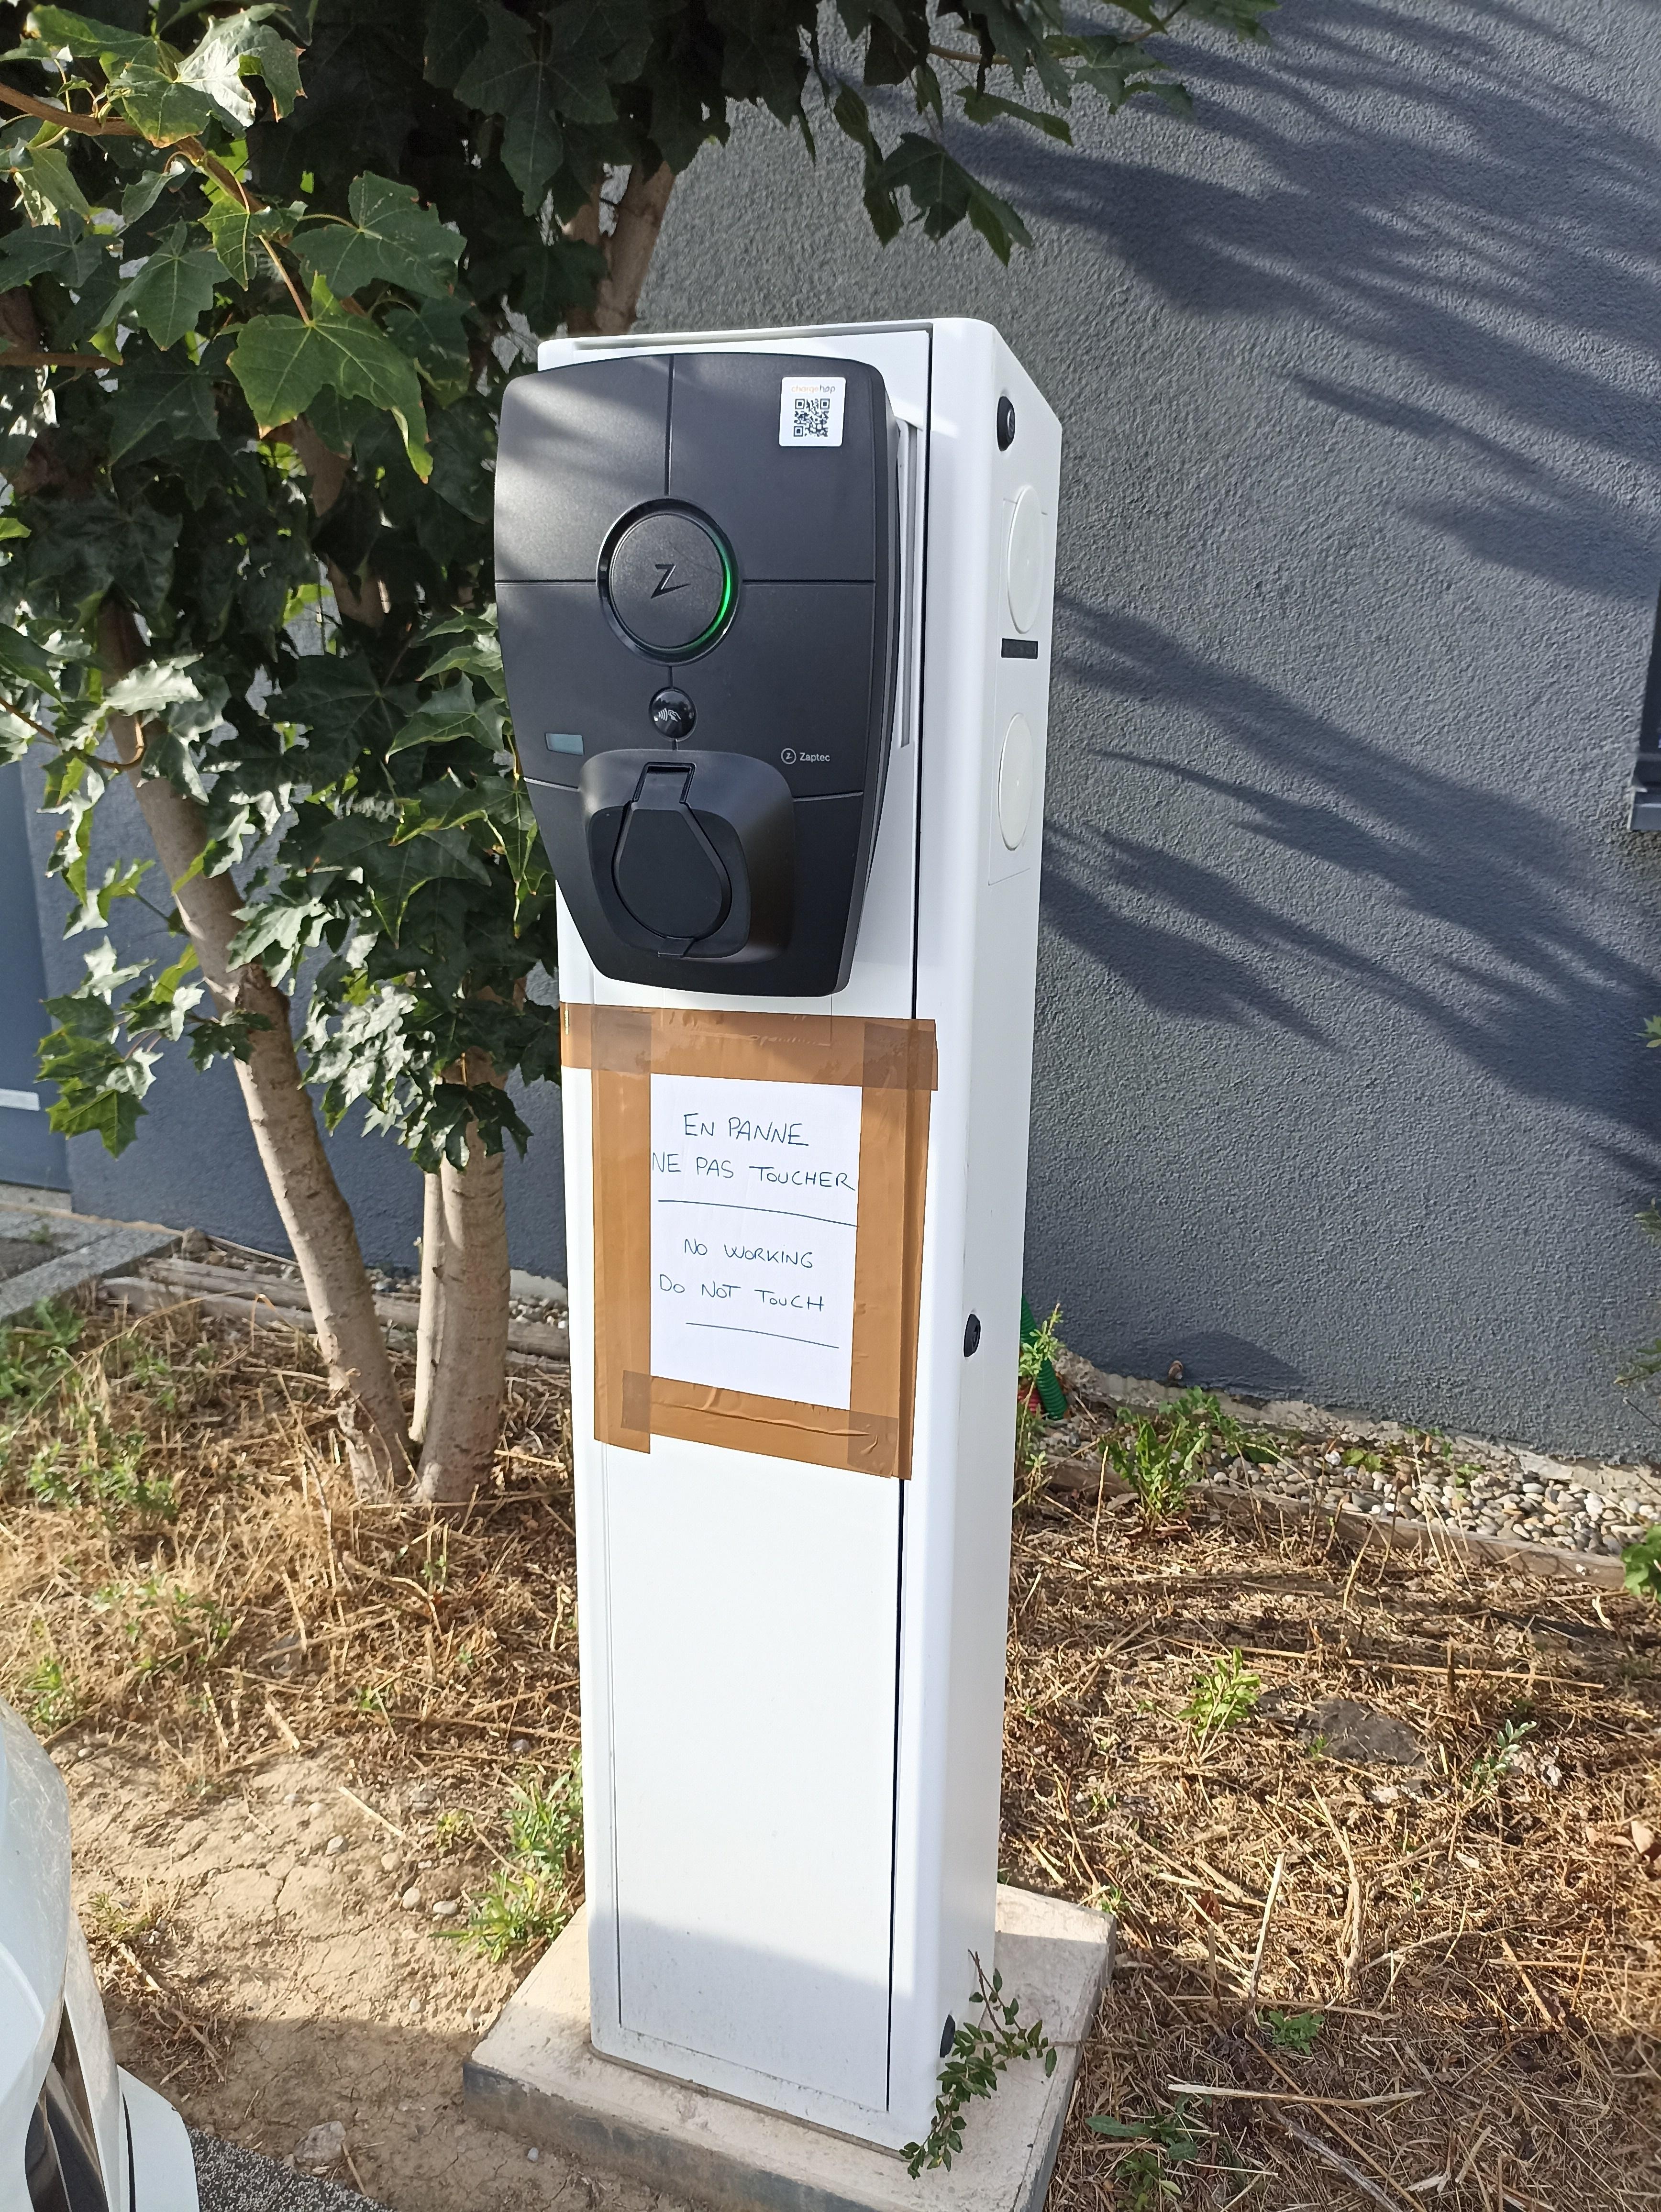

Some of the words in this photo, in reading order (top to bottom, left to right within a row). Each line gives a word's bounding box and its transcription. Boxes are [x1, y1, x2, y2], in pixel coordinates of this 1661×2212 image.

[799, 752, 830, 763] Zaptec
[684, 1113, 715, 1136] EN
[728, 1117, 809, 1146] PANNE
[652, 1151, 682, 1173] NE
[696, 1157, 734, 1179] PAS
[749, 1166, 856, 1191] TOUCHER
[684, 1239, 708, 1256] NO
[724, 1244, 813, 1269] WORKING
[702, 1281, 741, 1299] NOT
[754, 1289, 824, 1312] TOUCH
